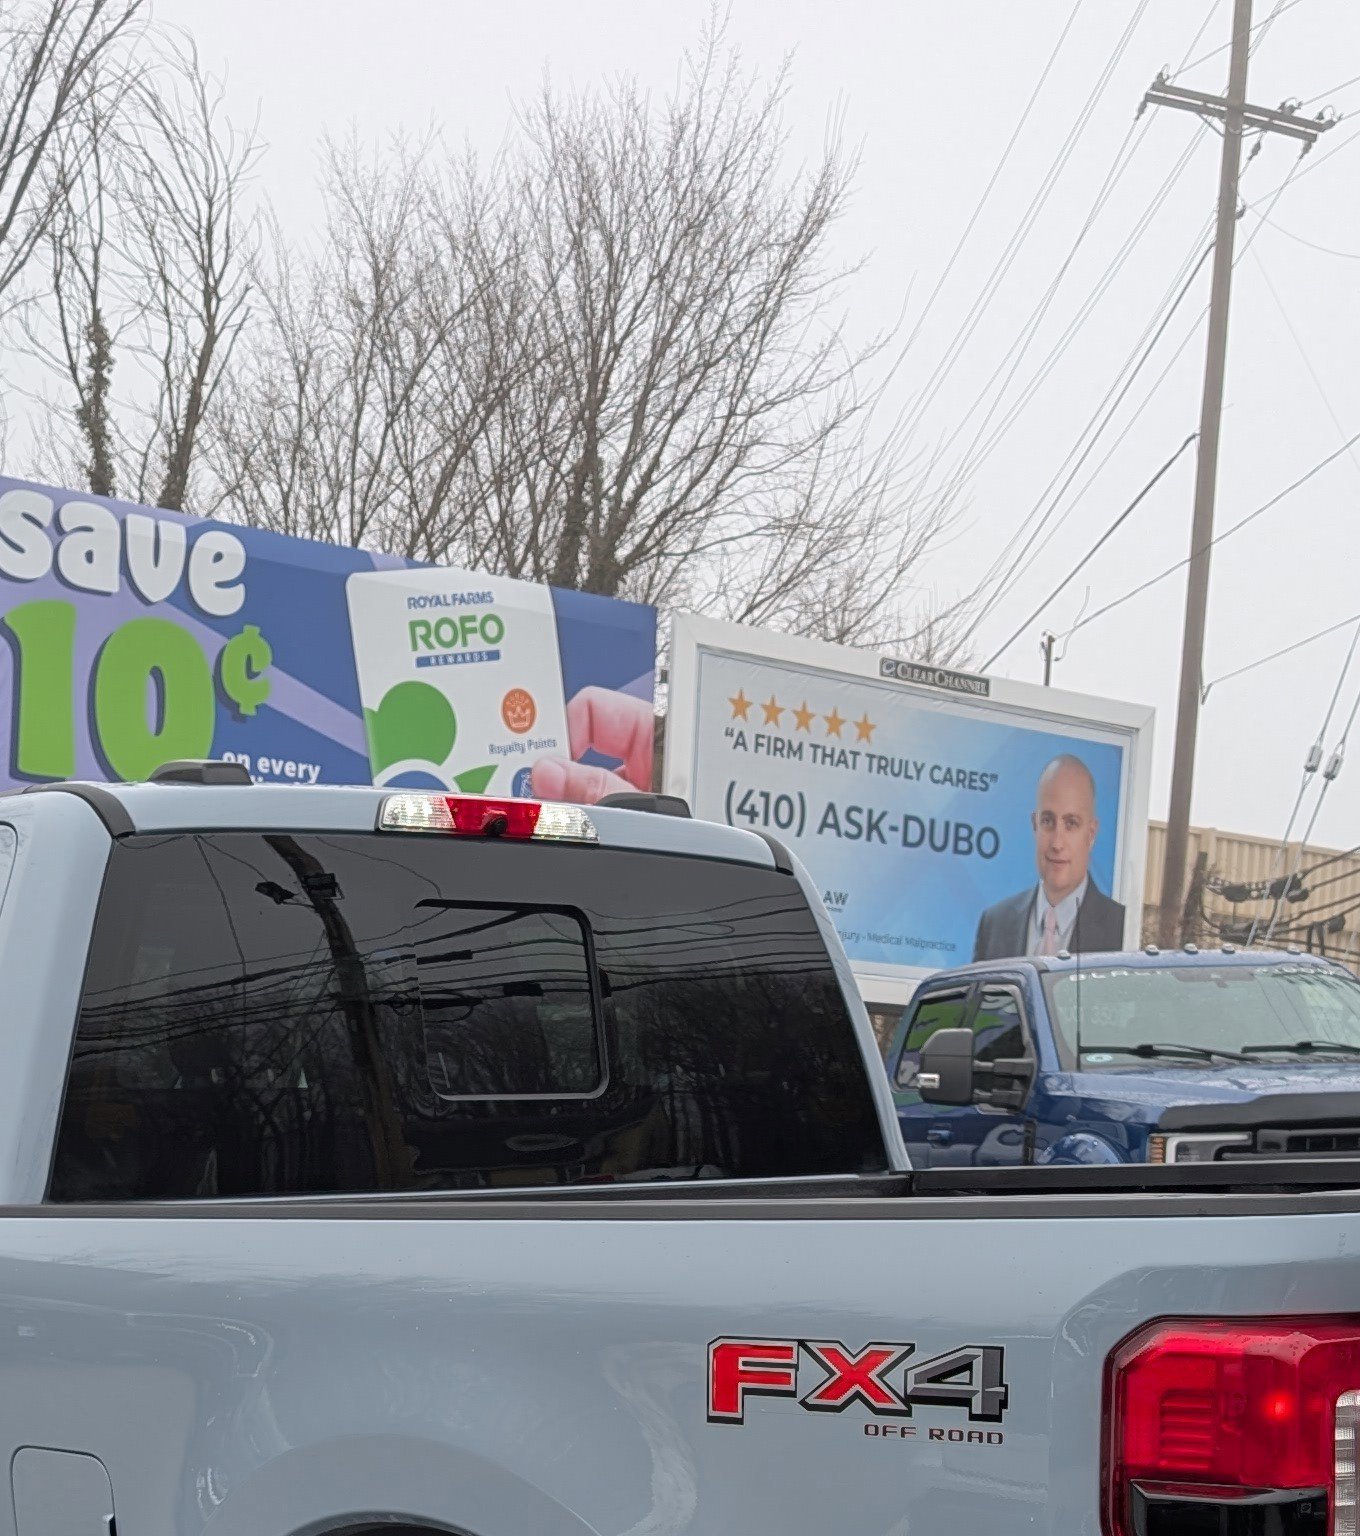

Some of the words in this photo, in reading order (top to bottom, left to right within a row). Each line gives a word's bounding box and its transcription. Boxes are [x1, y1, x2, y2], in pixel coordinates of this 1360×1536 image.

[407, 594, 450, 610] ROYAL
[451, 591, 494, 606] FARMS
[408, 613, 505, 652] ROFO
[257, 756, 321, 784] every
[754, 733, 804, 762] FIRM
[809, 742, 862, 771] THAT
[865, 752, 926, 782] TRULY
[724, 780, 806, 838] (410)
[816, 802, 1001, 860] ASK-DUBO
[866, 932, 902, 946] Medical
[904, 936, 957, 952] Malpractice
[707, 1335, 1009, 1425] FX4
[863, 1423, 917, 1439] OFF
[928, 1427, 1004, 1446] ROAD
